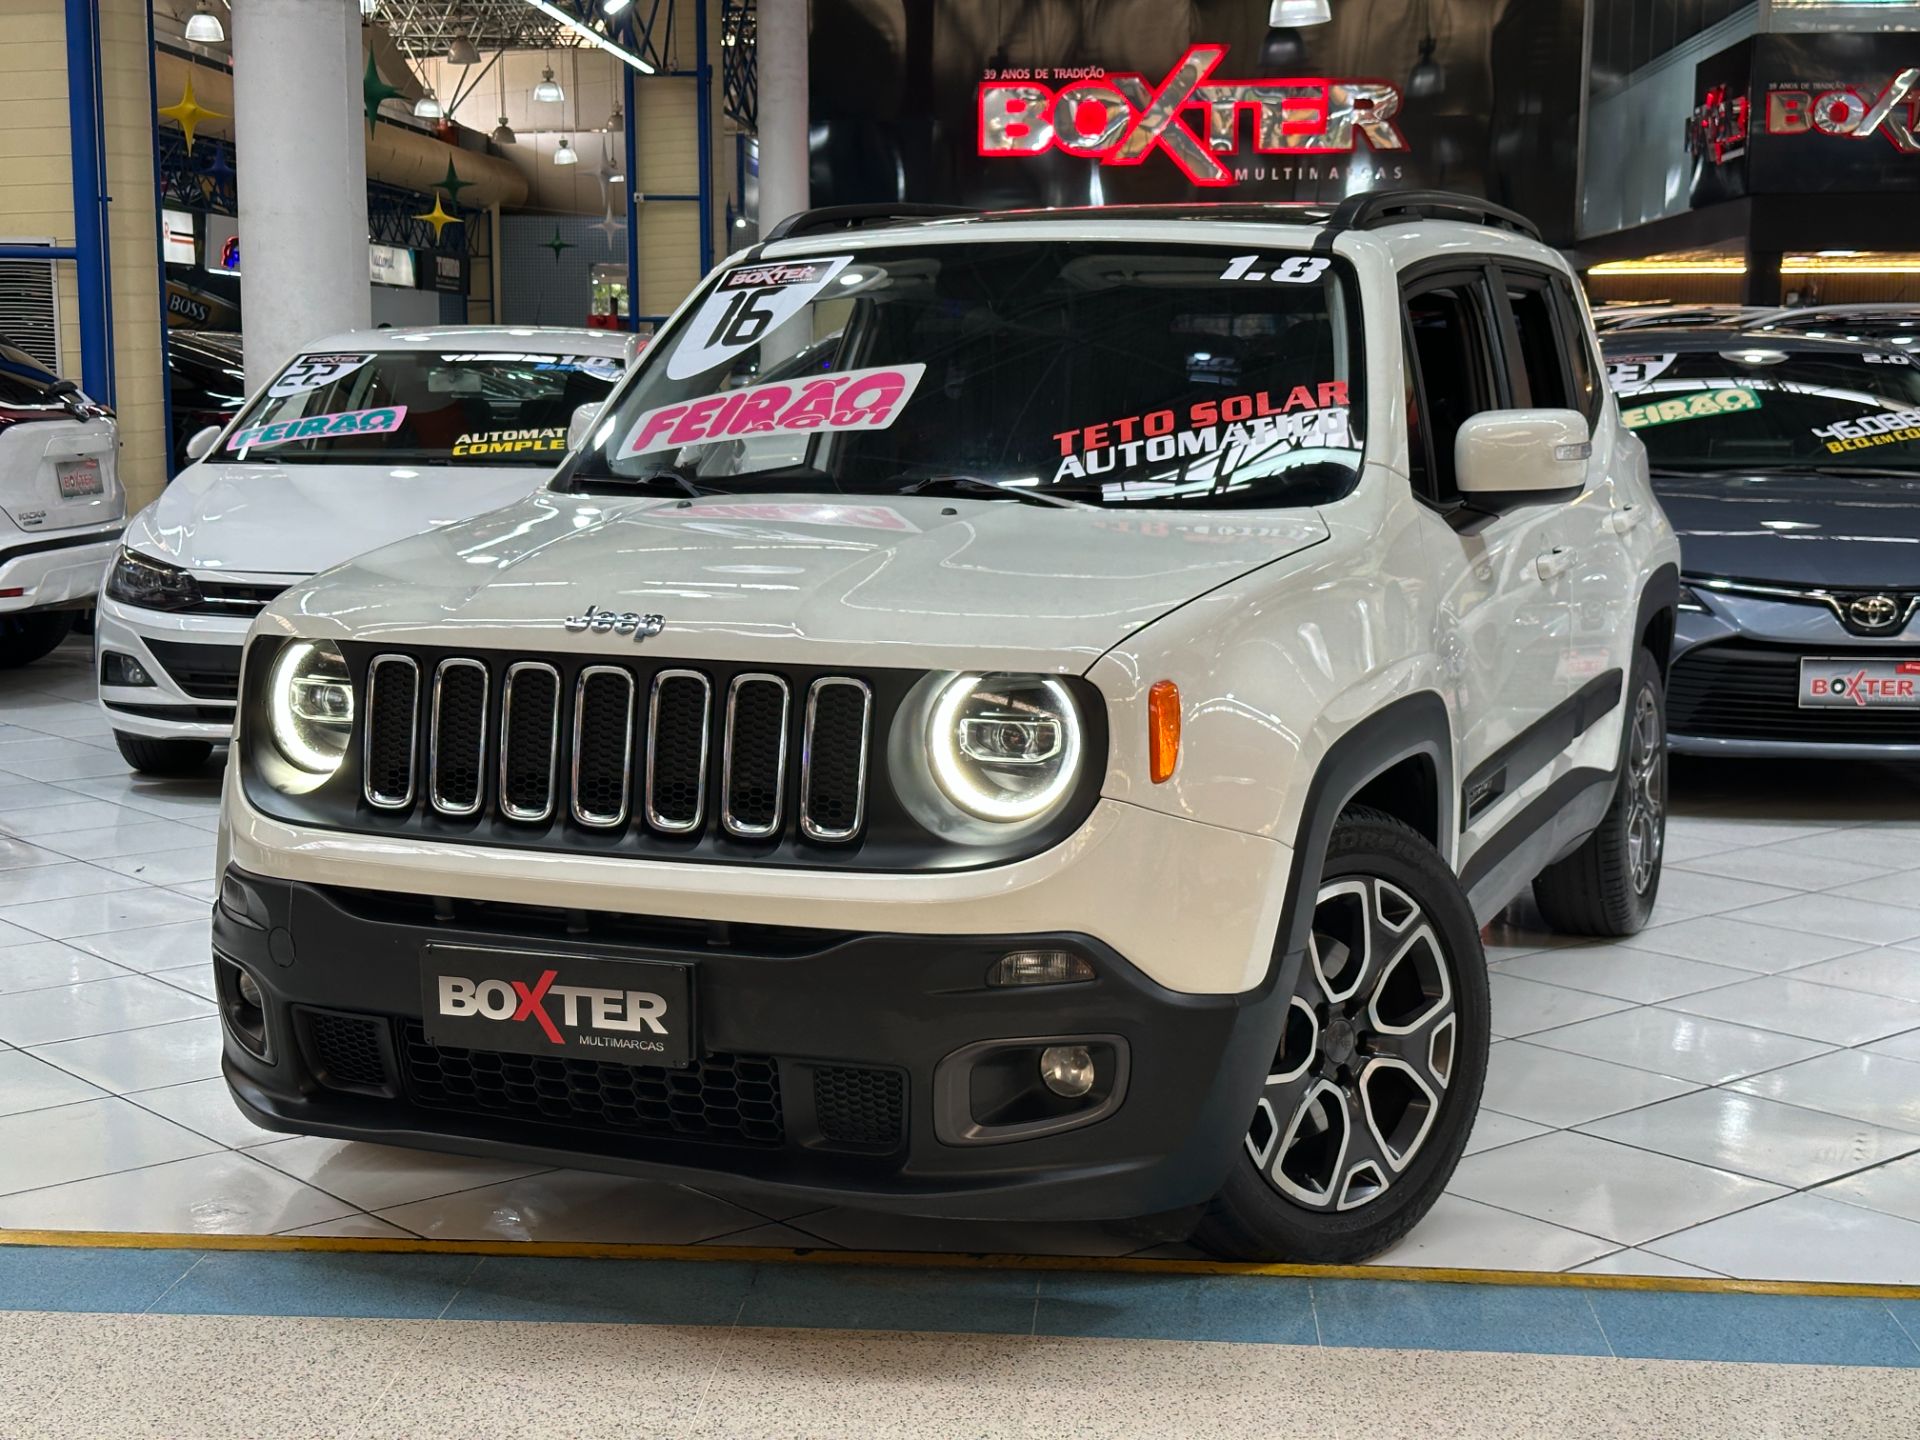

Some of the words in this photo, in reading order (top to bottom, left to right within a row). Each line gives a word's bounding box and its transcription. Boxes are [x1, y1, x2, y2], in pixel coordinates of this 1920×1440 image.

[984, 69, 997, 79] 39
[1000, 69, 1031, 79] ANOS
[1034, 69, 1049, 79] DE
[1053, 66, 1105, 80] TRADIÇÃO
[978, 43, 1411, 187] BOXTER
[728, 265, 816, 286] BOXTER
[1219, 254, 1331, 284] 1.8
[169, 294, 208, 321] BOSS
[703, 286, 788, 350] 16
[1862, 352, 1909, 365] 2.0
[276, 364, 341, 387] 22
[632, 371, 906, 451] FEIRÃO
[1053, 410, 1175, 457] TETO
[1190, 380, 1350, 428] SOLAR
[1621, 388, 1755, 428] EIRÃO
[1811, 407, 1920, 441] 46.088
[234, 409, 397, 448] FEIRÃO
[455, 427, 567, 445] AUTOMAT
[1892, 427, 1920, 441] CO
[452, 439, 566, 456] COMPLE
[564, 605, 666, 642] Jeep
[1810, 669, 1914, 706] BOXTER
[438, 970, 669, 1045] BOXTER
[579, 1034, 664, 1052] MULTIMARCAS
